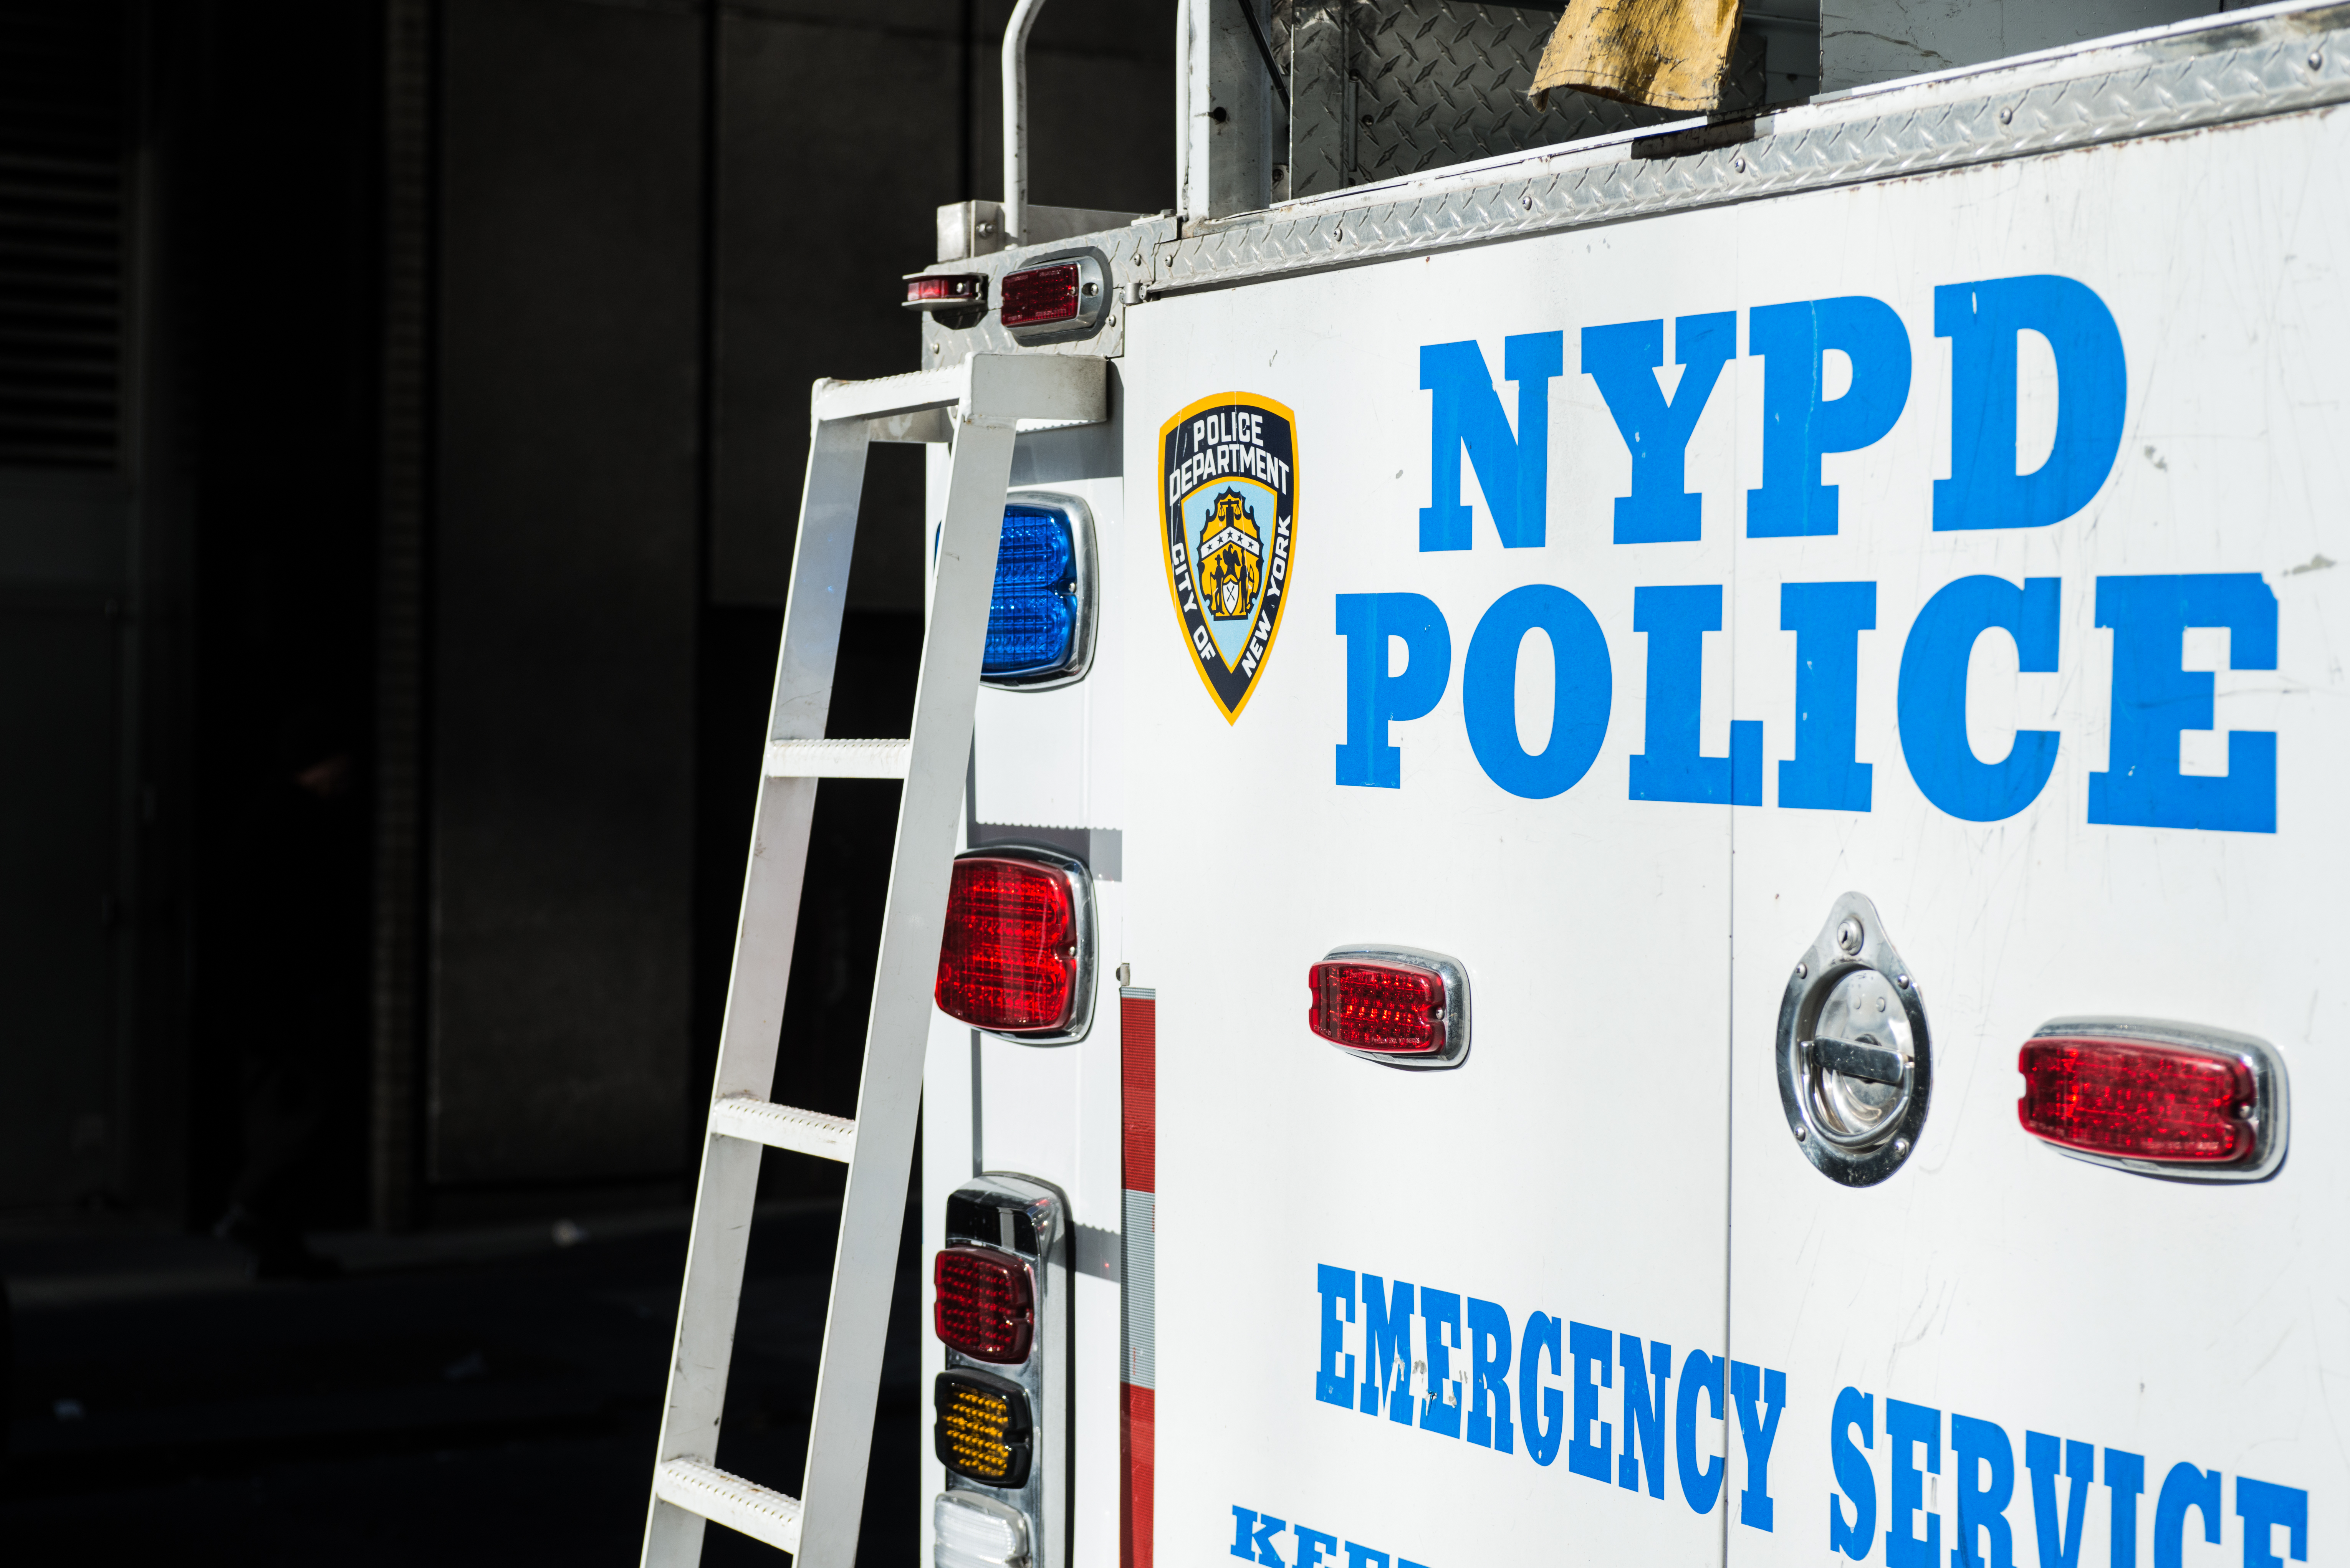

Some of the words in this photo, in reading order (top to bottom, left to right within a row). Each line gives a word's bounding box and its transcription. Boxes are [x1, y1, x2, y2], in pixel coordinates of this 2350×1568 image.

[1170, 444, 1289, 506] DEPARTMENT
[1194, 412, 1264, 453] POLICE
[1420, 275, 2127, 552] NYPD
[1172, 543, 1197, 613] CITY
[1193, 625, 1215, 661] OF
[1241, 610, 1272, 678] NEW
[1267, 514, 1291, 597] YORK
[1336, 573, 2278, 834] POLICE
[1316, 1263, 1786, 1533] EMERGENCY
[1230, 1505, 1433, 1568] KEE
